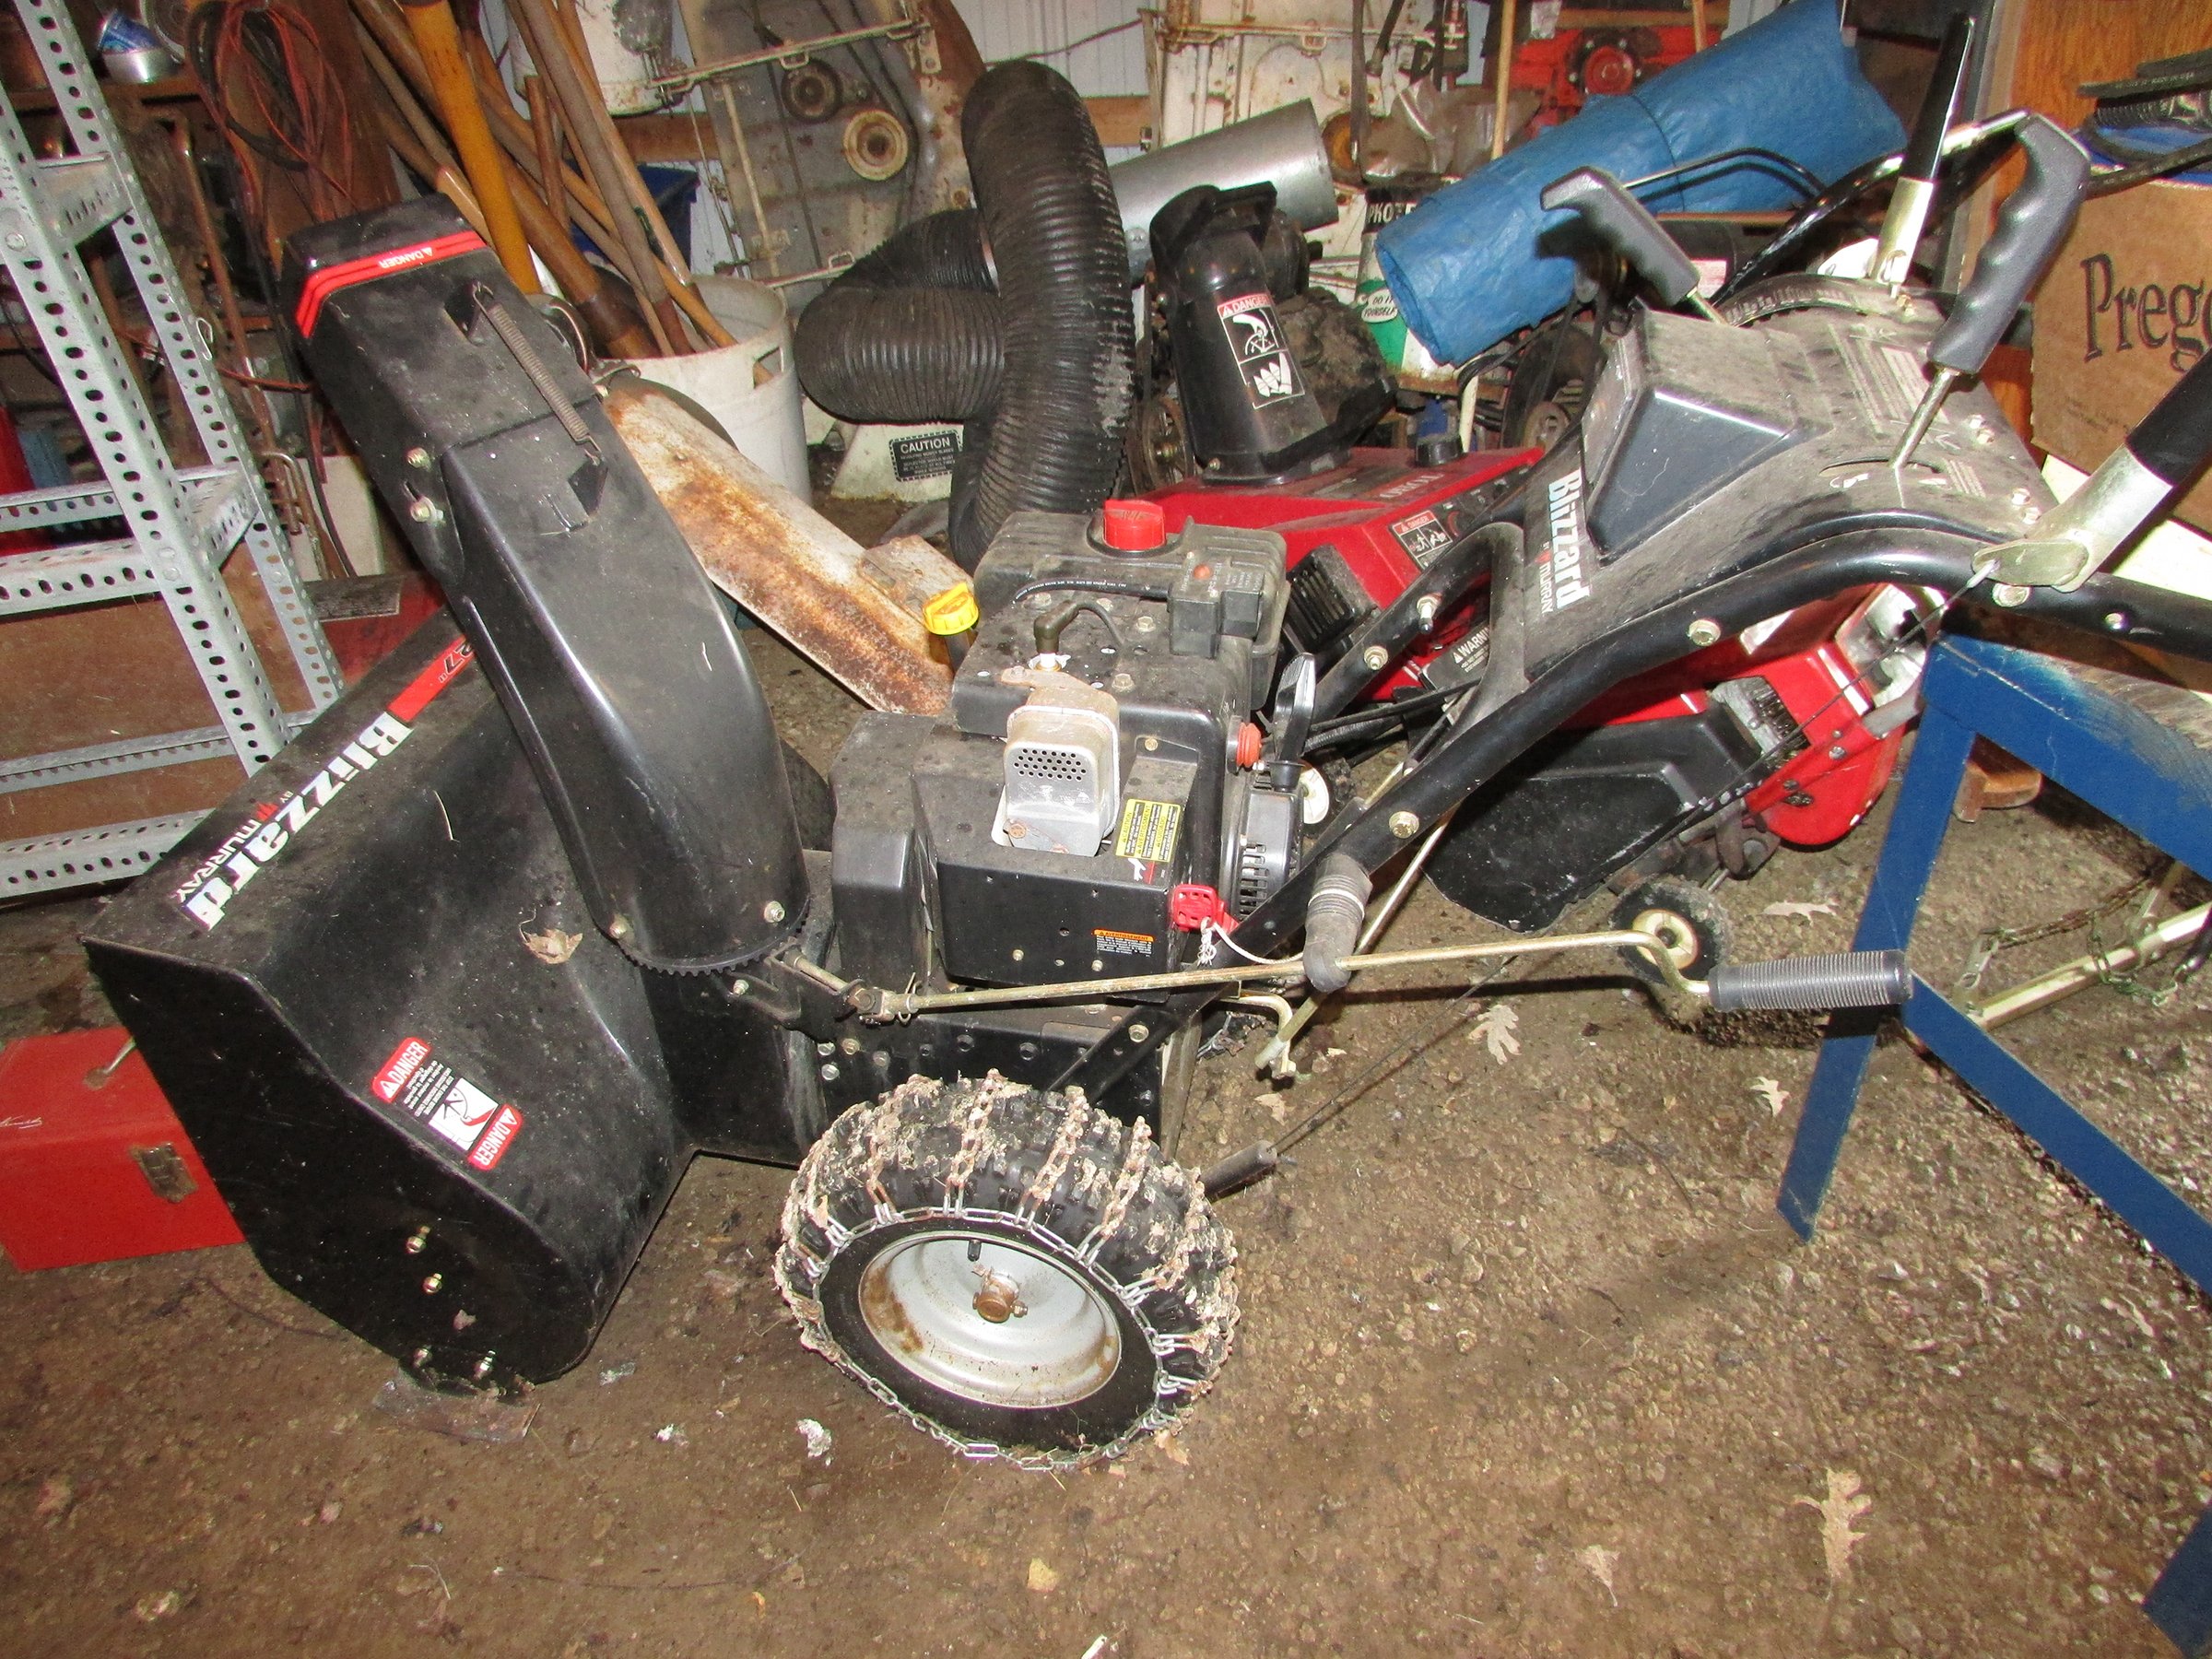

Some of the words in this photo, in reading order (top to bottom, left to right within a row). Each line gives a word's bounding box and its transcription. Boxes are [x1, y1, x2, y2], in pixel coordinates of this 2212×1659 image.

[378, 249, 424, 269] DANGER
[1232, 295, 1270, 311] DANGER
[900, 436, 950, 453] CAUTION
[1549, 467, 1590, 609] Blizzard
[1539, 562, 1553, 613] MURRAY
[280, 791, 294, 803] BY
[185, 712, 415, 930] Blizzard
[174, 819, 262, 902] MURRAY
[387, 1041, 428, 1085] DANGER
[473, 1122, 511, 1166] DANGER
